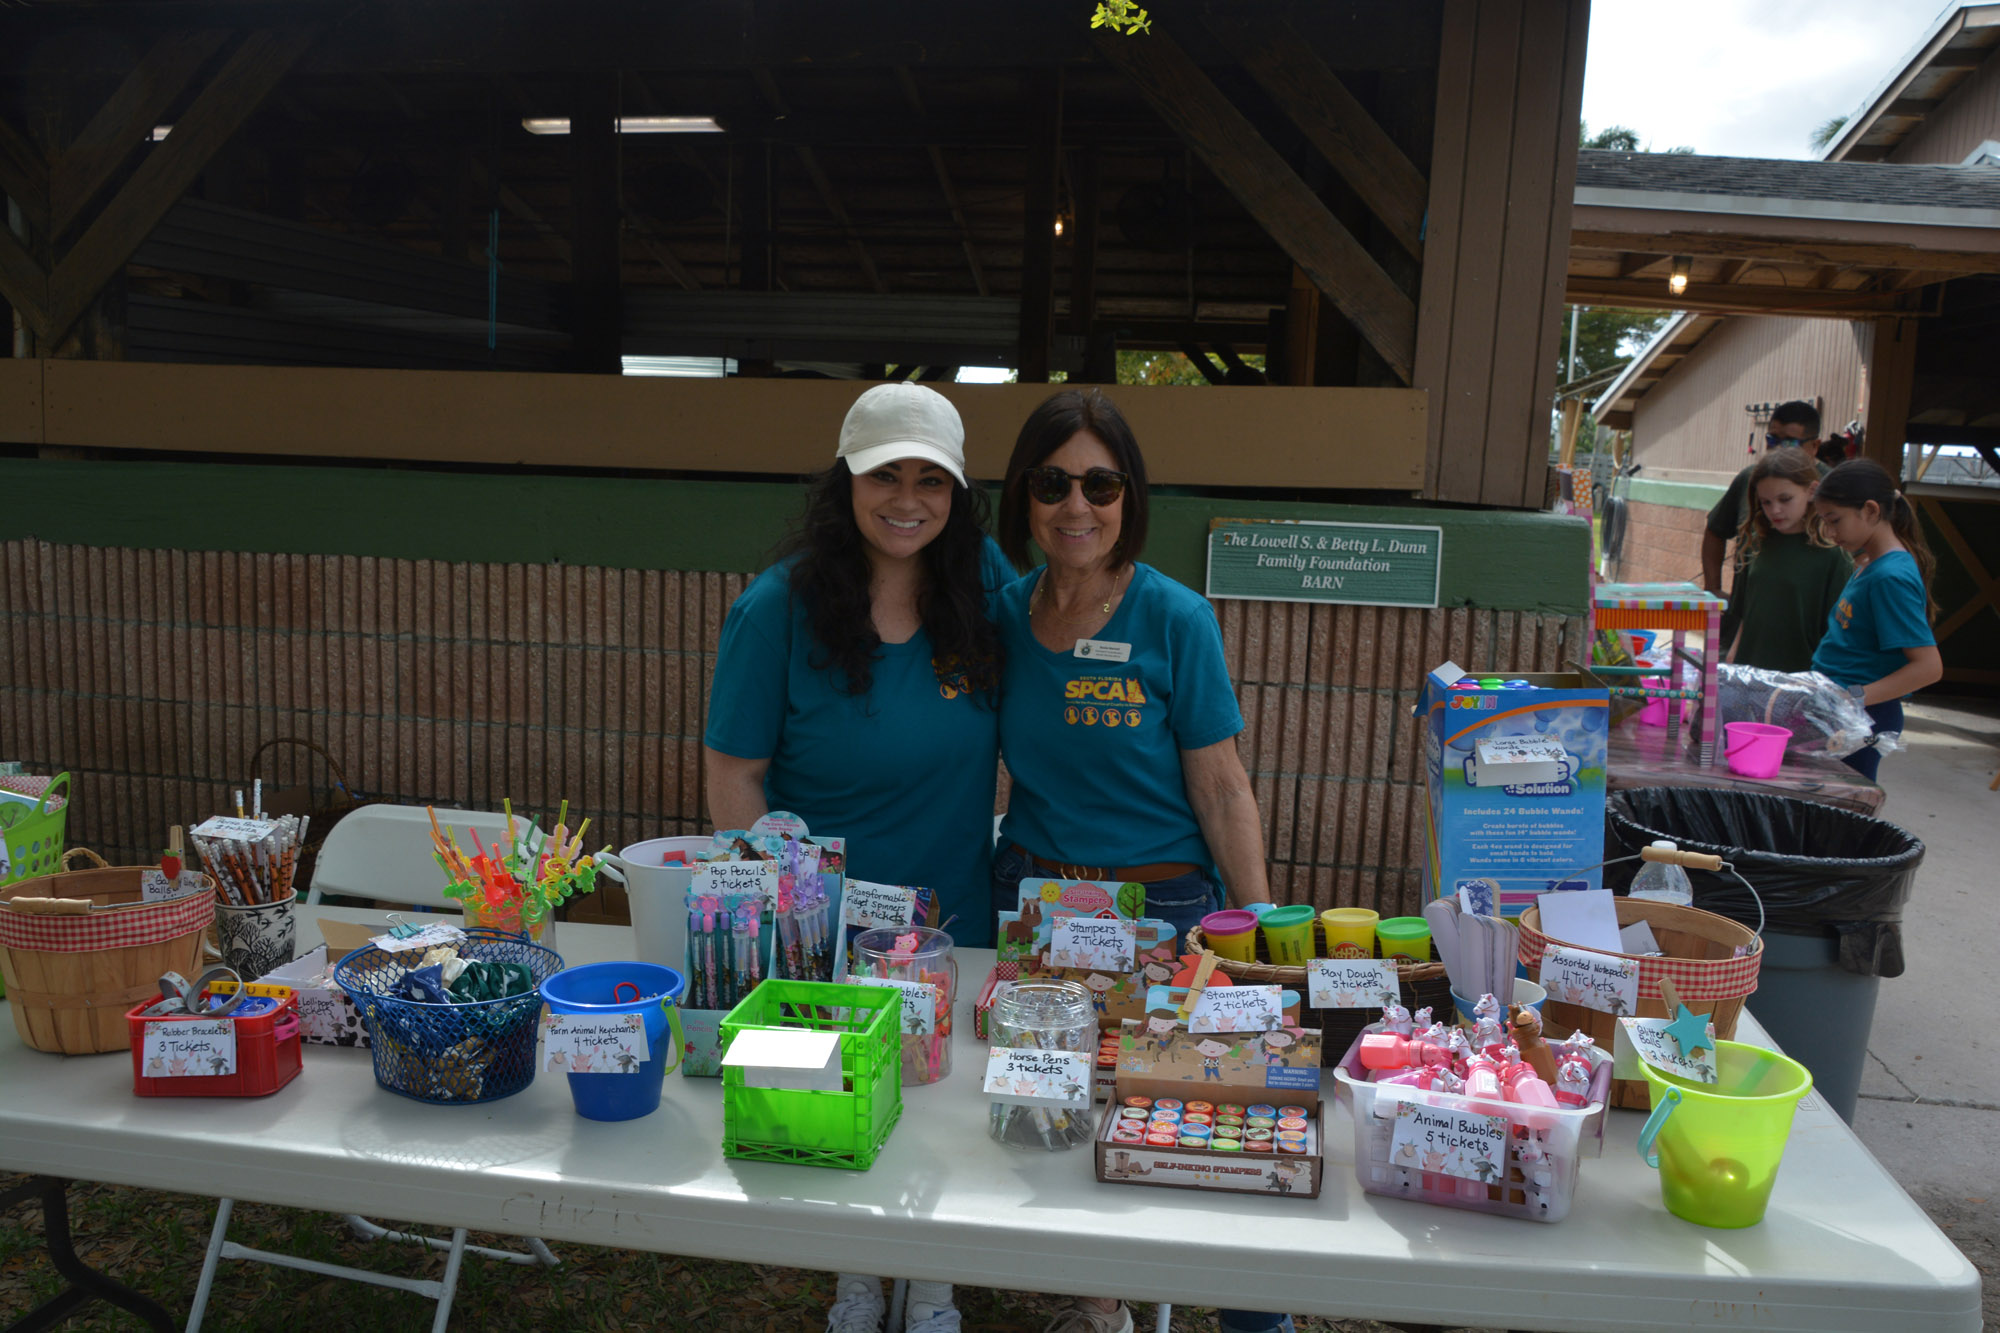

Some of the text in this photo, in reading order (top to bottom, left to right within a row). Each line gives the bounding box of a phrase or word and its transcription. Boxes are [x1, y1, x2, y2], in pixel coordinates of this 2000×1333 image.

[1223, 532, 1428, 554] The Lowell S. & Betty L. Dunn
[1256, 554, 1391, 572] Family Foundation
[1301, 575, 1344, 589] BARN
[1064, 680, 1126, 701] SPCA
[1450, 695, 1498, 710] JOYIN
[1516, 784, 1569, 794] Solution
[1464, 808, 1501, 816] Includes
[1551, 807, 1584, 815] Wands!
[710, 865, 767, 878] Pop Pencils
[148, 884, 171, 894] Balls
[711, 878, 761, 890] 5 tickets
[849, 886, 908, 903] Transformable
[1063, 894, 1107, 905] Stampers
[846, 895, 868, 910] Fidget
[861, 910, 905, 922] 5 tickets
[1068, 922, 1117, 936] Stampers
[1072, 935, 1124, 948] 2 Tickets
[1552, 955, 1628, 979] Assorted Notepads
[1320, 968, 1383, 981] Play Dough
[1332, 980, 1378, 989] 5 tickets
[1561, 970, 1615, 993] 4 Tickets
[1206, 988, 1260, 1000] Stampers
[302, 996, 335, 1009] Lollipops
[1213, 998, 1268, 1012] 2 tickets
[162, 1026, 228, 1036] Rubber Bracelets
[550, 1026, 569, 1035] Farm
[571, 1025, 596, 1034] Animal
[686, 1024, 713, 1032] Pencils
[1637, 1025, 1666, 1040] Glitter
[160, 1040, 210, 1052] 3 Tickets
[574, 1036, 619, 1047] 4 tickets
[1639, 1035, 1662, 1049] Balls
[1009, 1053, 1070, 1065] Horse Pens
[1651, 1051, 1694, 1068] 2 tickets
[1006, 1063, 1063, 1075] 3 tickets
[1414, 1112, 1503, 1140] Animal Bubbles
[1425, 1130, 1489, 1151] 5 tickets
[1153, 1161, 1262, 1176] SELF-INKING STAMPERS
